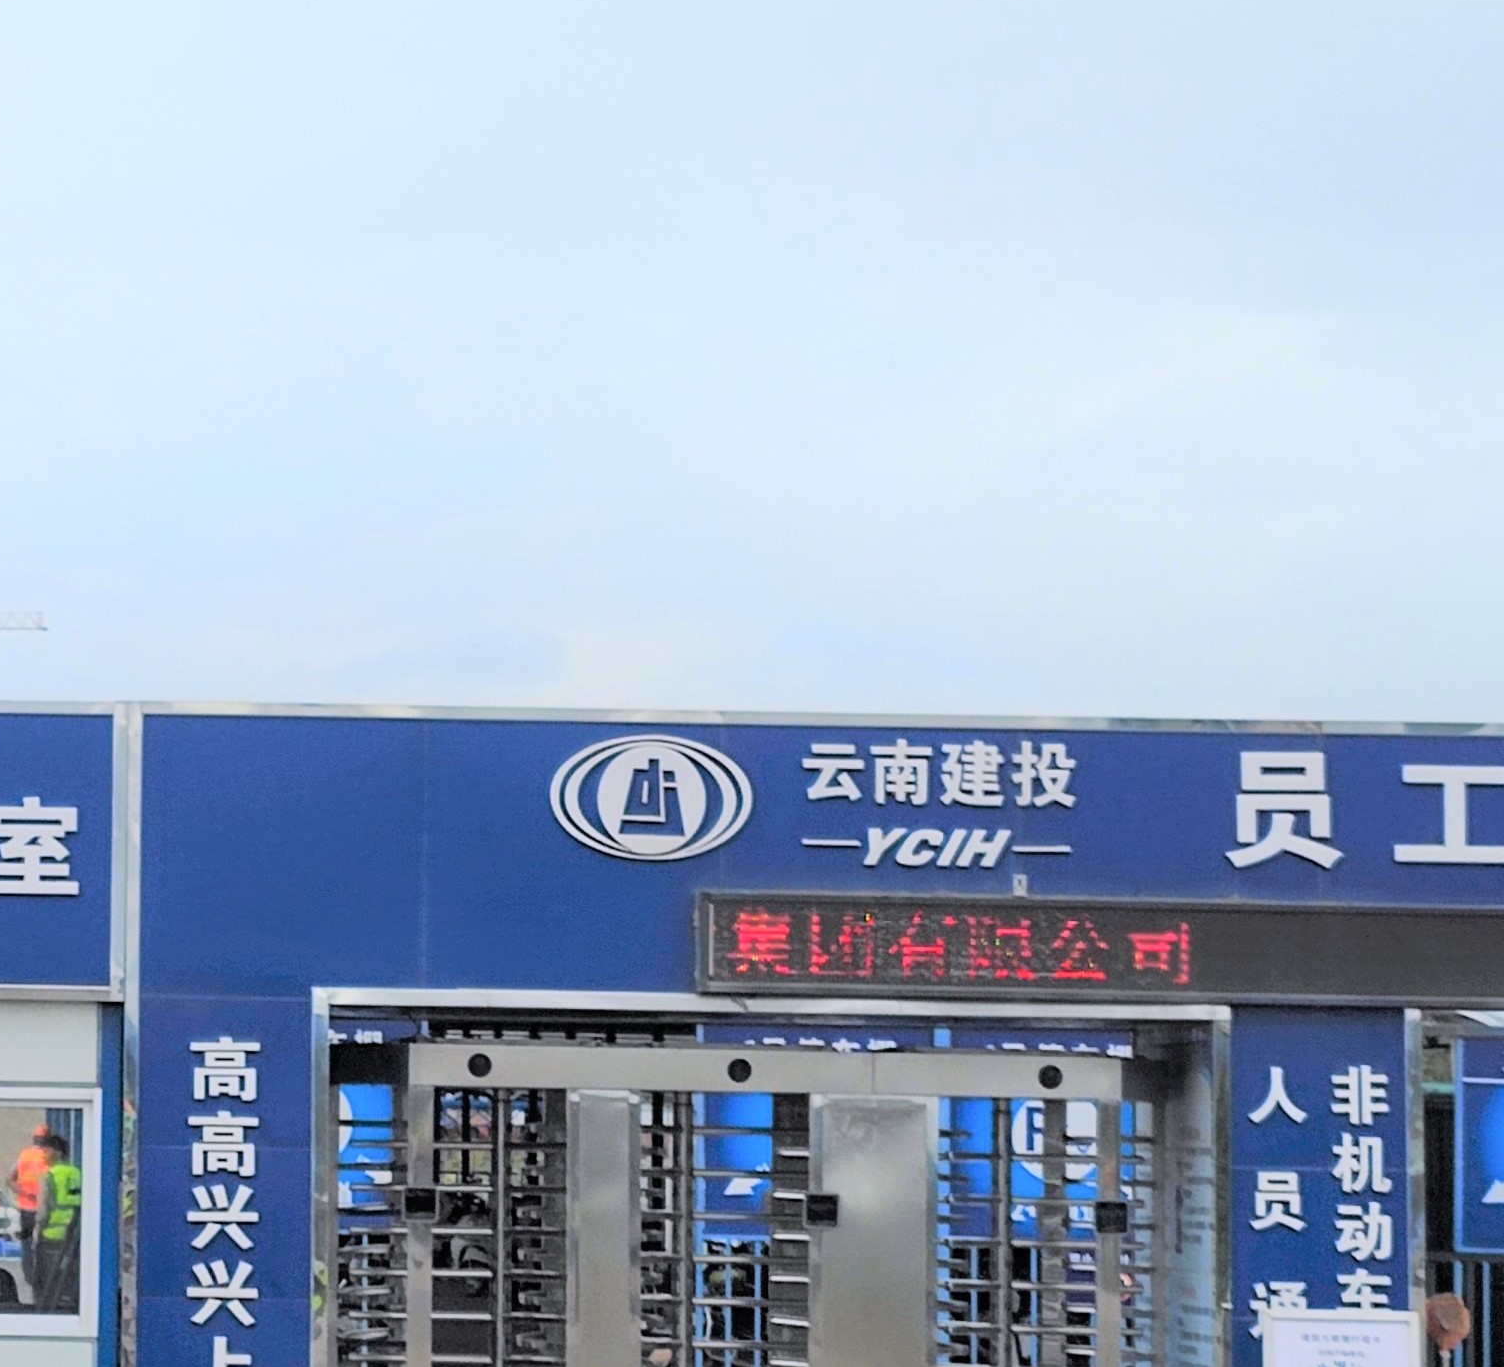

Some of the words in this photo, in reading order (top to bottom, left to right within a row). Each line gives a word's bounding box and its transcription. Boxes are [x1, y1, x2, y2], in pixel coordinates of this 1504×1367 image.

[802, 738, 1077, 807] 云南建投
[863, 827, 1012, 867] YCIH
